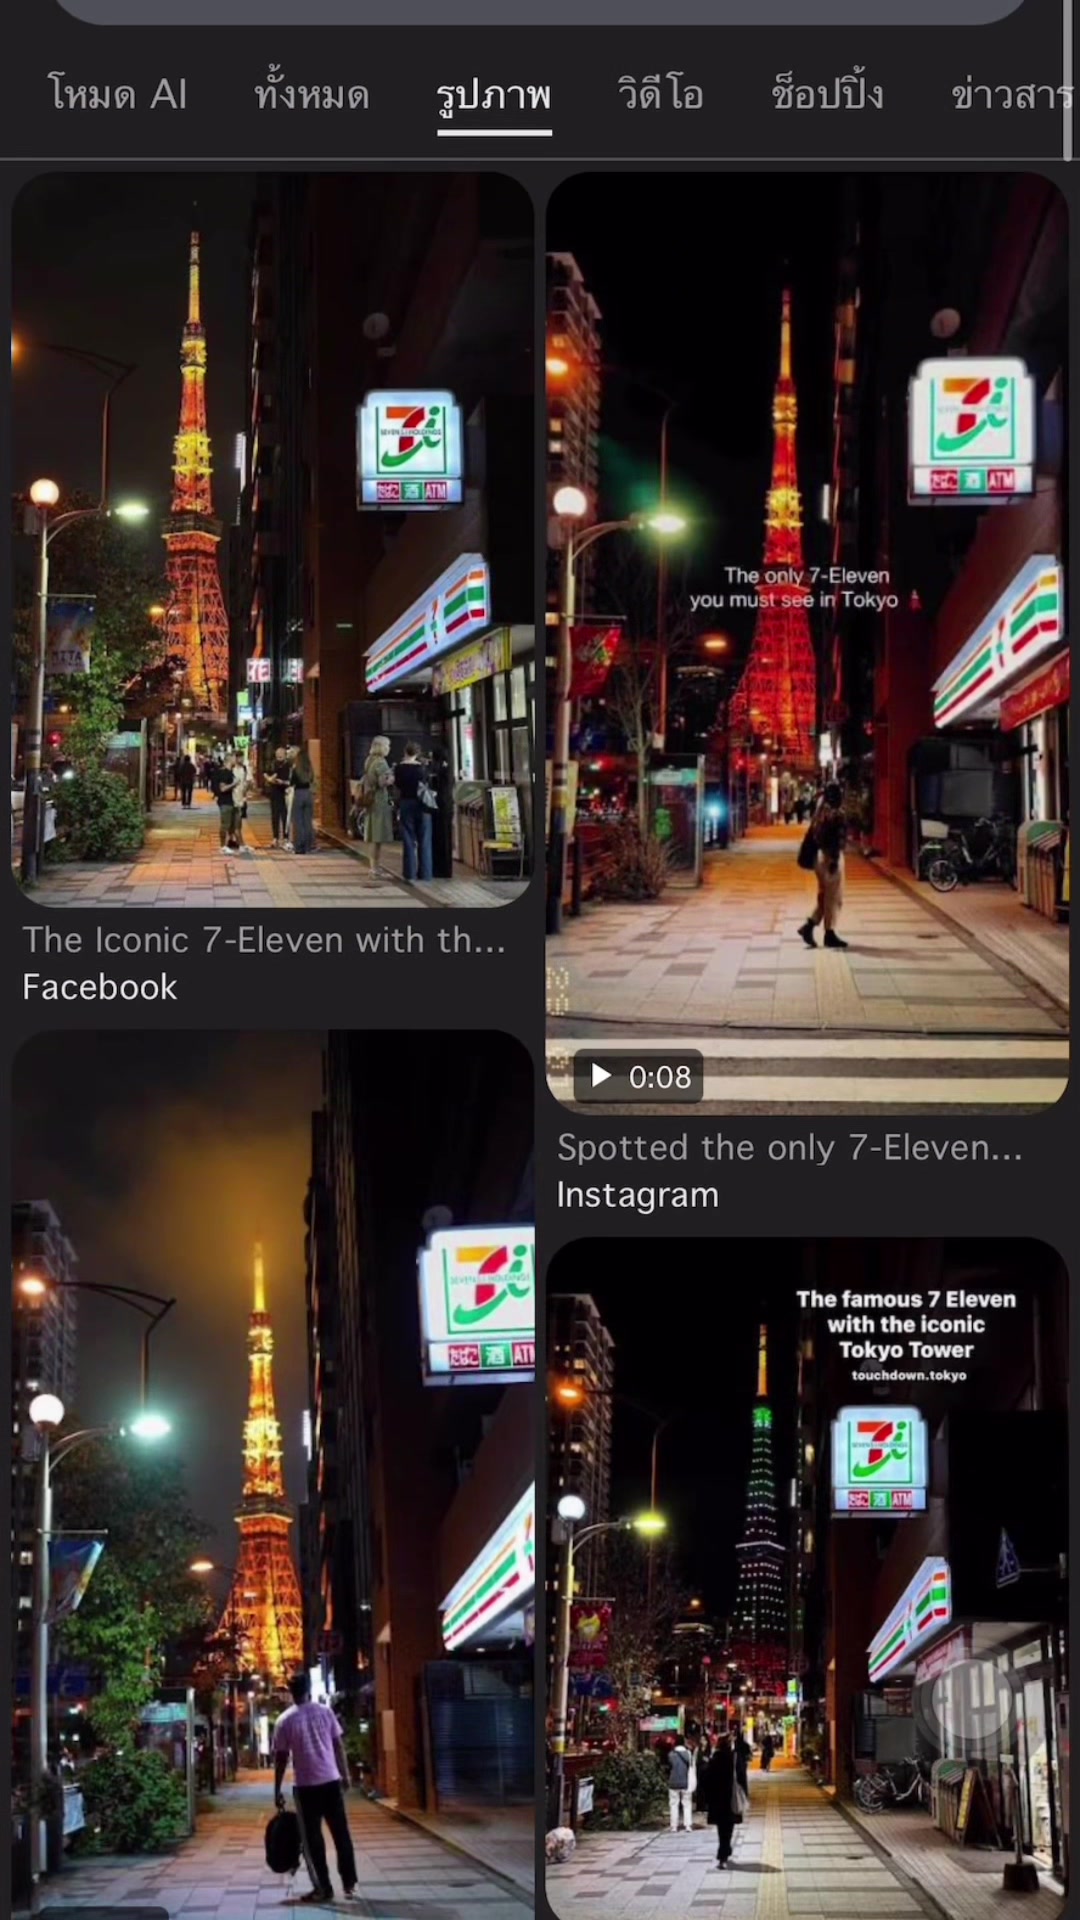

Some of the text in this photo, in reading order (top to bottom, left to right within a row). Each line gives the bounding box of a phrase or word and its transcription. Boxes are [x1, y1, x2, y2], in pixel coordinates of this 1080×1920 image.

[47, 71, 186, 109] โหมด AI
[255, 64, 369, 110] ทั้งหมด
[437, 77, 551, 119] รูปภาพ
[618, 71, 704, 110] วิดีโอ
[772, 65, 884, 110] ช็อปปิ้ง
[952, 75, 1075, 109] ข่าวสาร
[425, 483, 446, 499] ATM
[989, 471, 1014, 490] ATM
[22, 925, 82, 954] The
[97, 925, 189, 954] Iconic
[203, 925, 343, 954] 7-Eleven
[355, 925, 424, 954] with
[23, 971, 178, 1001] Facebook
[629, 1065, 692, 1089] 0:08
[558, 1132, 688, 1166] Spotted
[702, 1132, 755, 1161] the
[768, 1132, 836, 1166] only
[558, 1180, 719, 1215] Instagram
